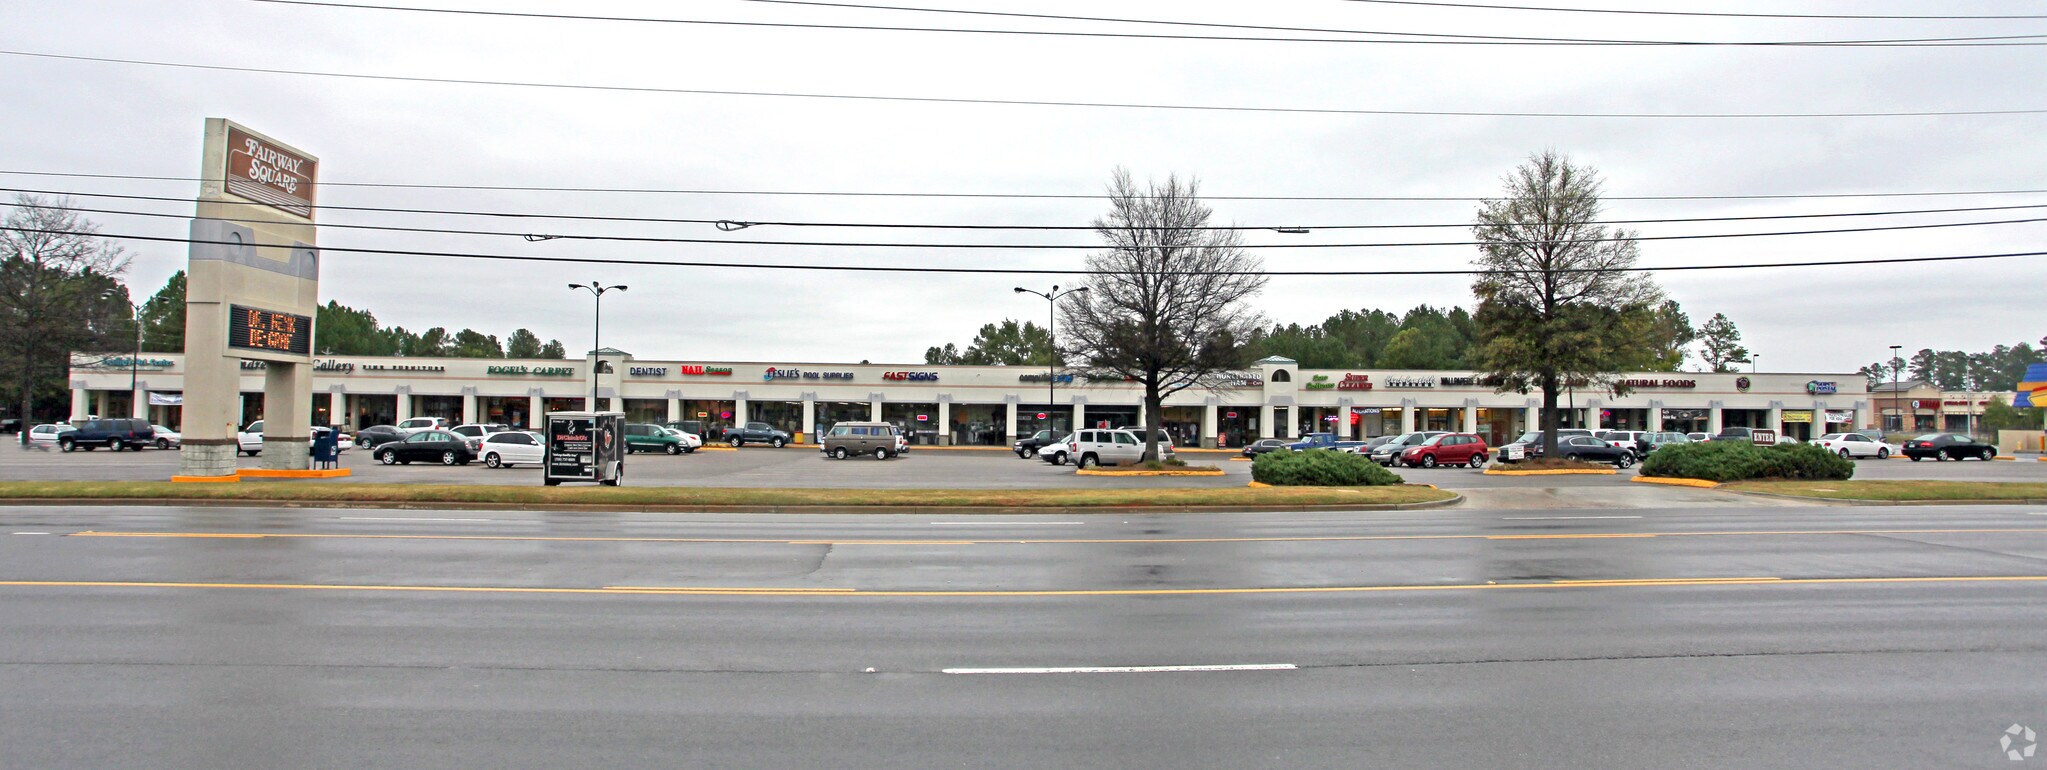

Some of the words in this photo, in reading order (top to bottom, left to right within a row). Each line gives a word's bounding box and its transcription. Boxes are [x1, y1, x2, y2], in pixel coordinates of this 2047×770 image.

[245, 138, 303, 174] FAIRWAY
[249, 159, 298, 194] SQUARE
[313, 359, 355, 374] Gallery
[533, 366, 575, 377] CARPET
[630, 367, 667, 376] DENTIST
[681, 365, 705, 375] NAIL
[767, 368, 800, 379] LESLIE'S
[1346, 373, 1368, 382] SUPER
[1662, 379, 1696, 388] FOODS
[1754, 433, 1774, 442] ENTER
